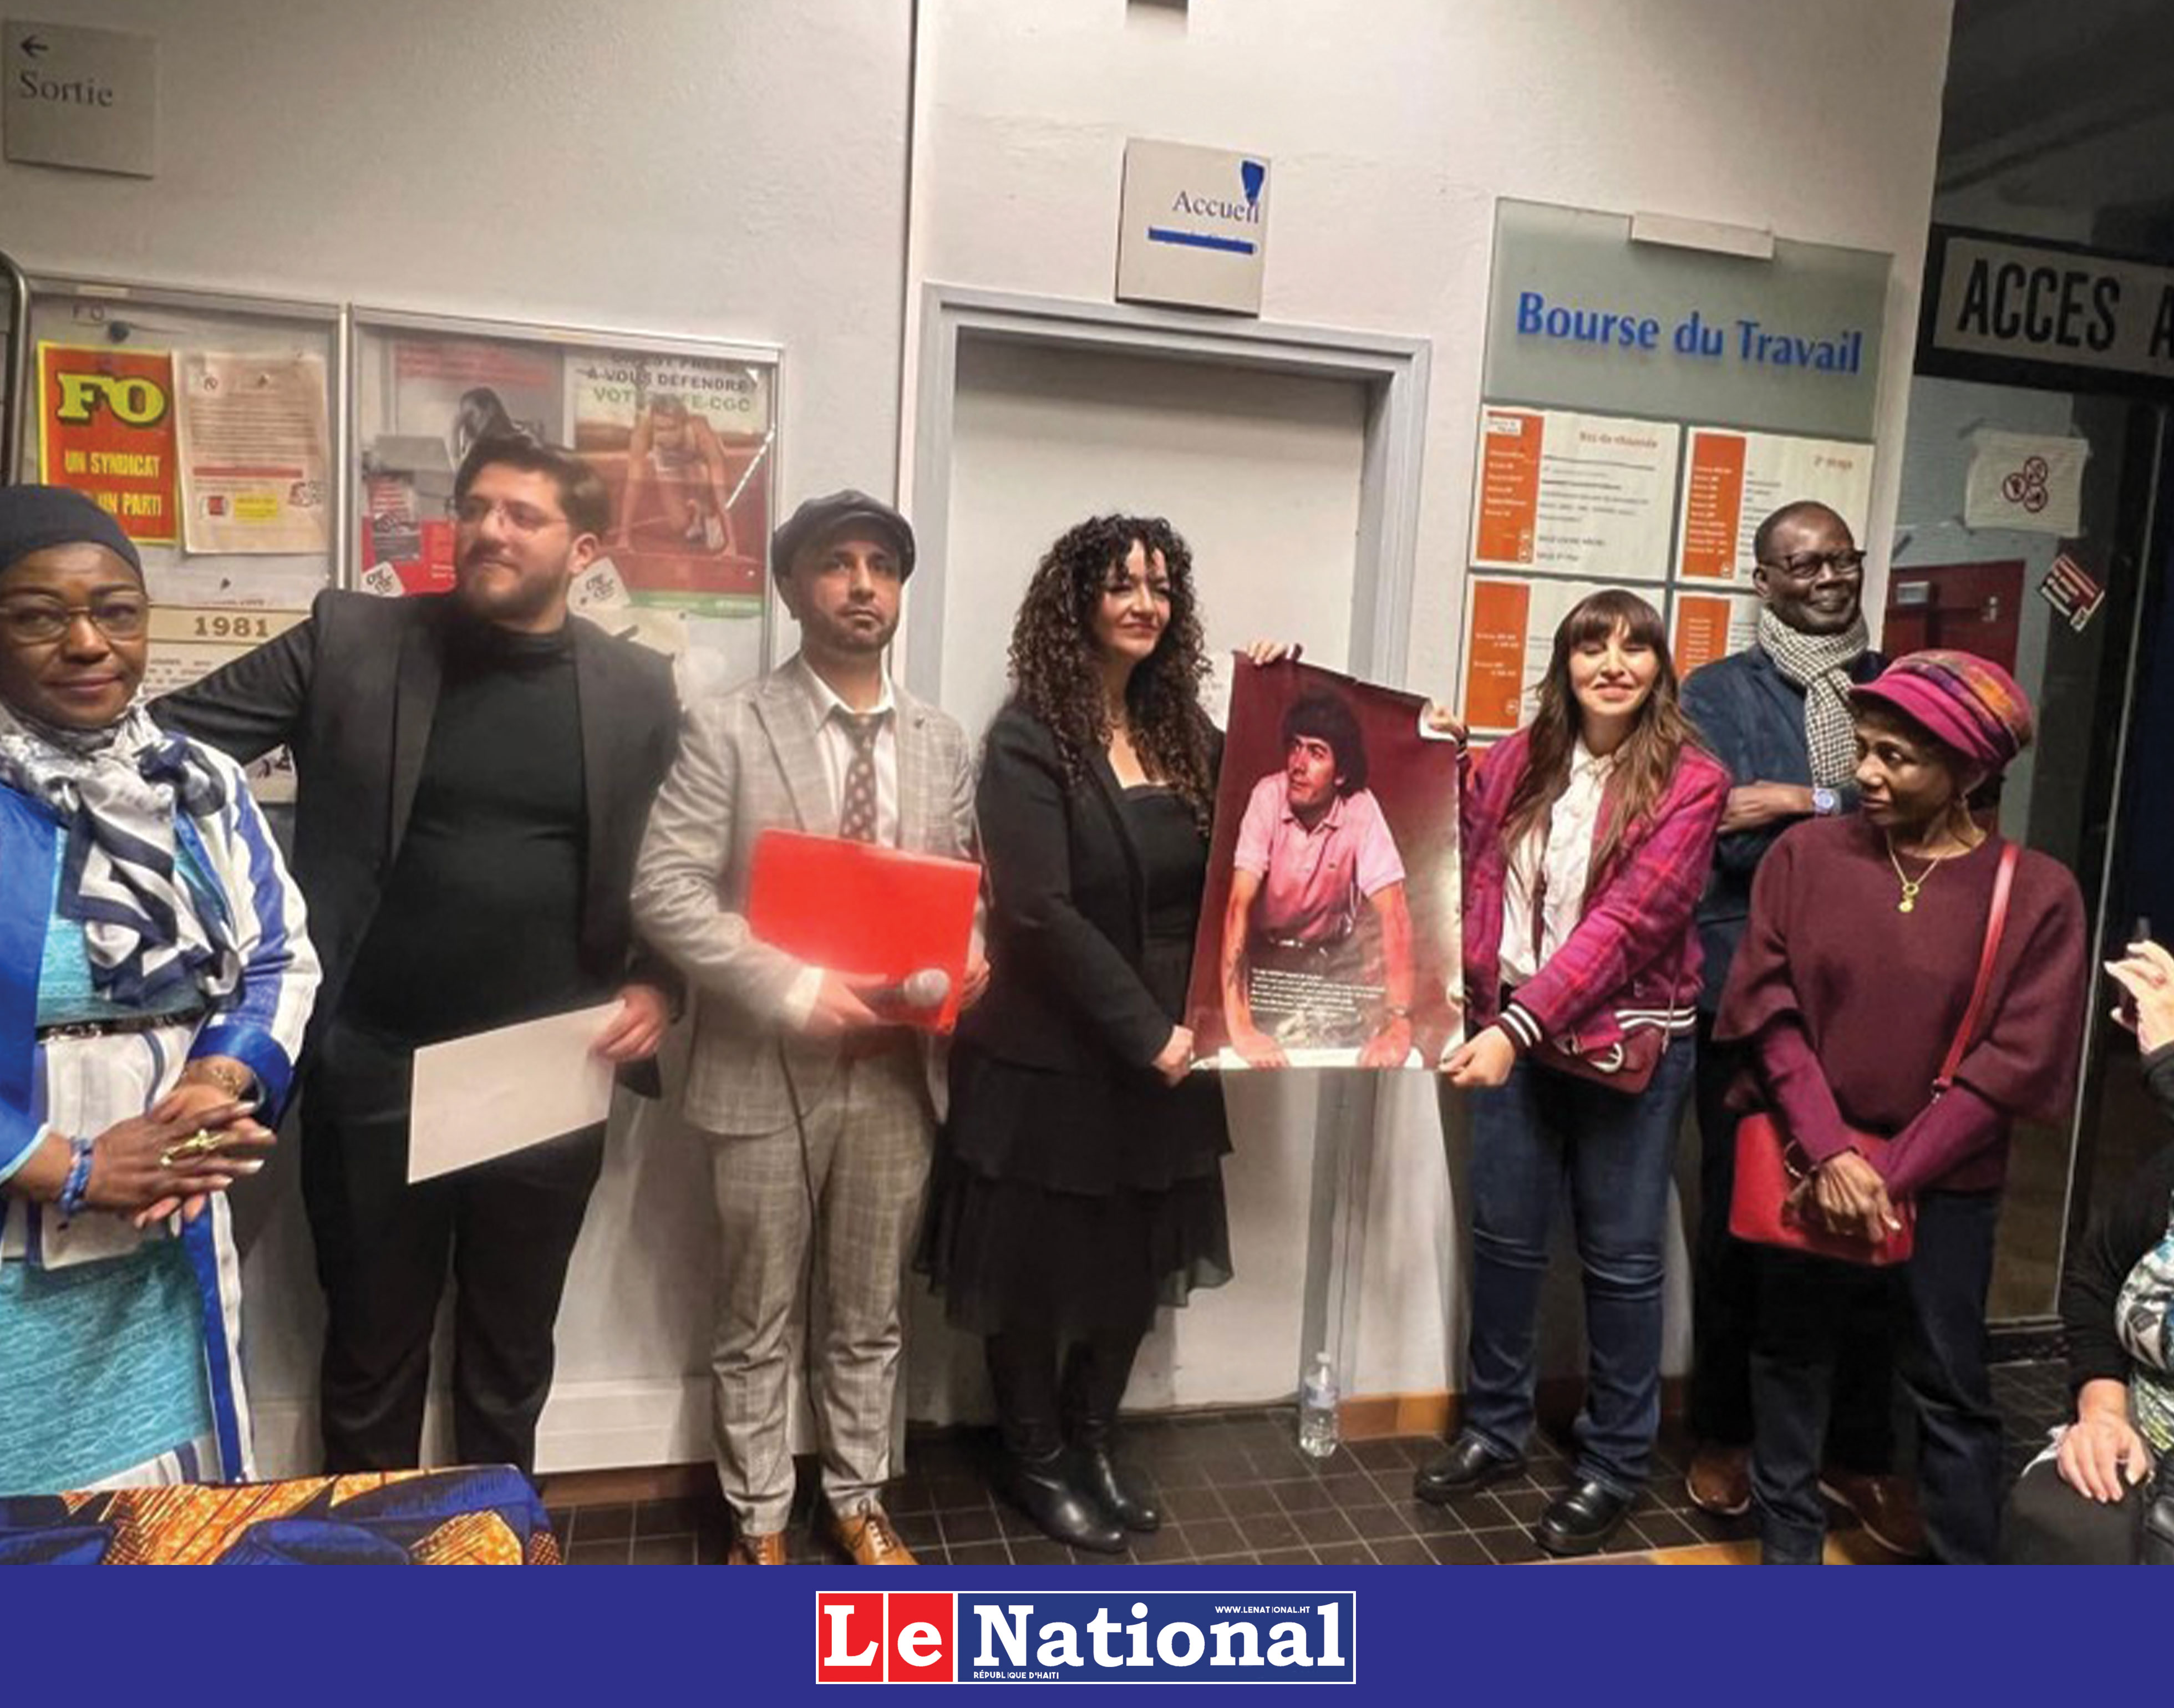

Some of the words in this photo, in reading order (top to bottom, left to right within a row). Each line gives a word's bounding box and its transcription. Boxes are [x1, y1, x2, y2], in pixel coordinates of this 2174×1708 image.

[20, 70, 113, 107] Sortie
[1956, 258, 2121, 352] ACCES
[1516, 291, 1660, 351] Bourse
[1674, 311, 1724, 357] du
[1736, 319, 1863, 375] Travail
[56, 370, 166, 425] FO
[90, 452, 160, 479] SYNDICAT
[122, 492, 162, 517] PARTI
[195, 616, 270, 638] 1981
